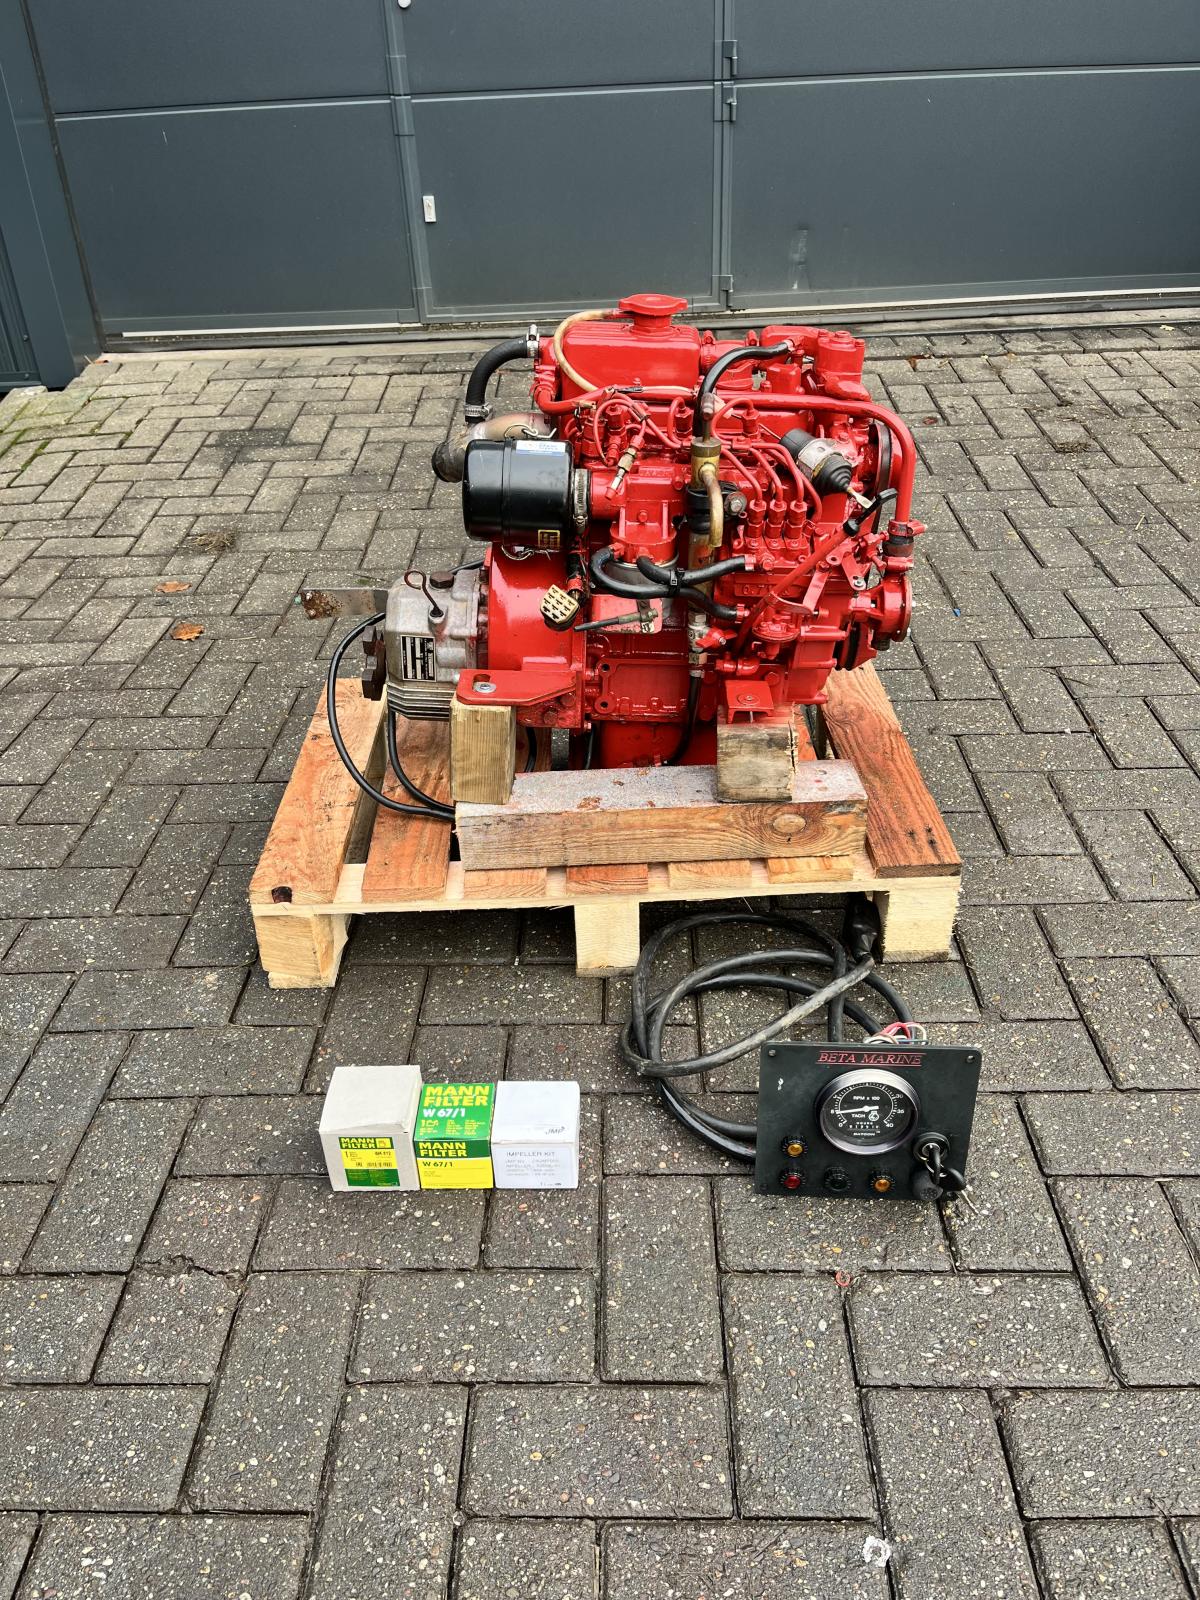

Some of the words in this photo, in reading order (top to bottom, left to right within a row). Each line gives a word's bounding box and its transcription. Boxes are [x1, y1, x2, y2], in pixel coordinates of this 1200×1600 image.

[817, 1052, 856, 1063] BETA
[861, 1053, 922, 1065] MARINE
[425, 1085, 490, 1096] MANN
[423, 1095, 488, 1107] FILTER
[422, 1108, 436, 1118] W
[437, 1107, 466, 1119] 67/1
[418, 1142, 466, 1150] MANN
[419, 1149, 468, 1157] FILTER
